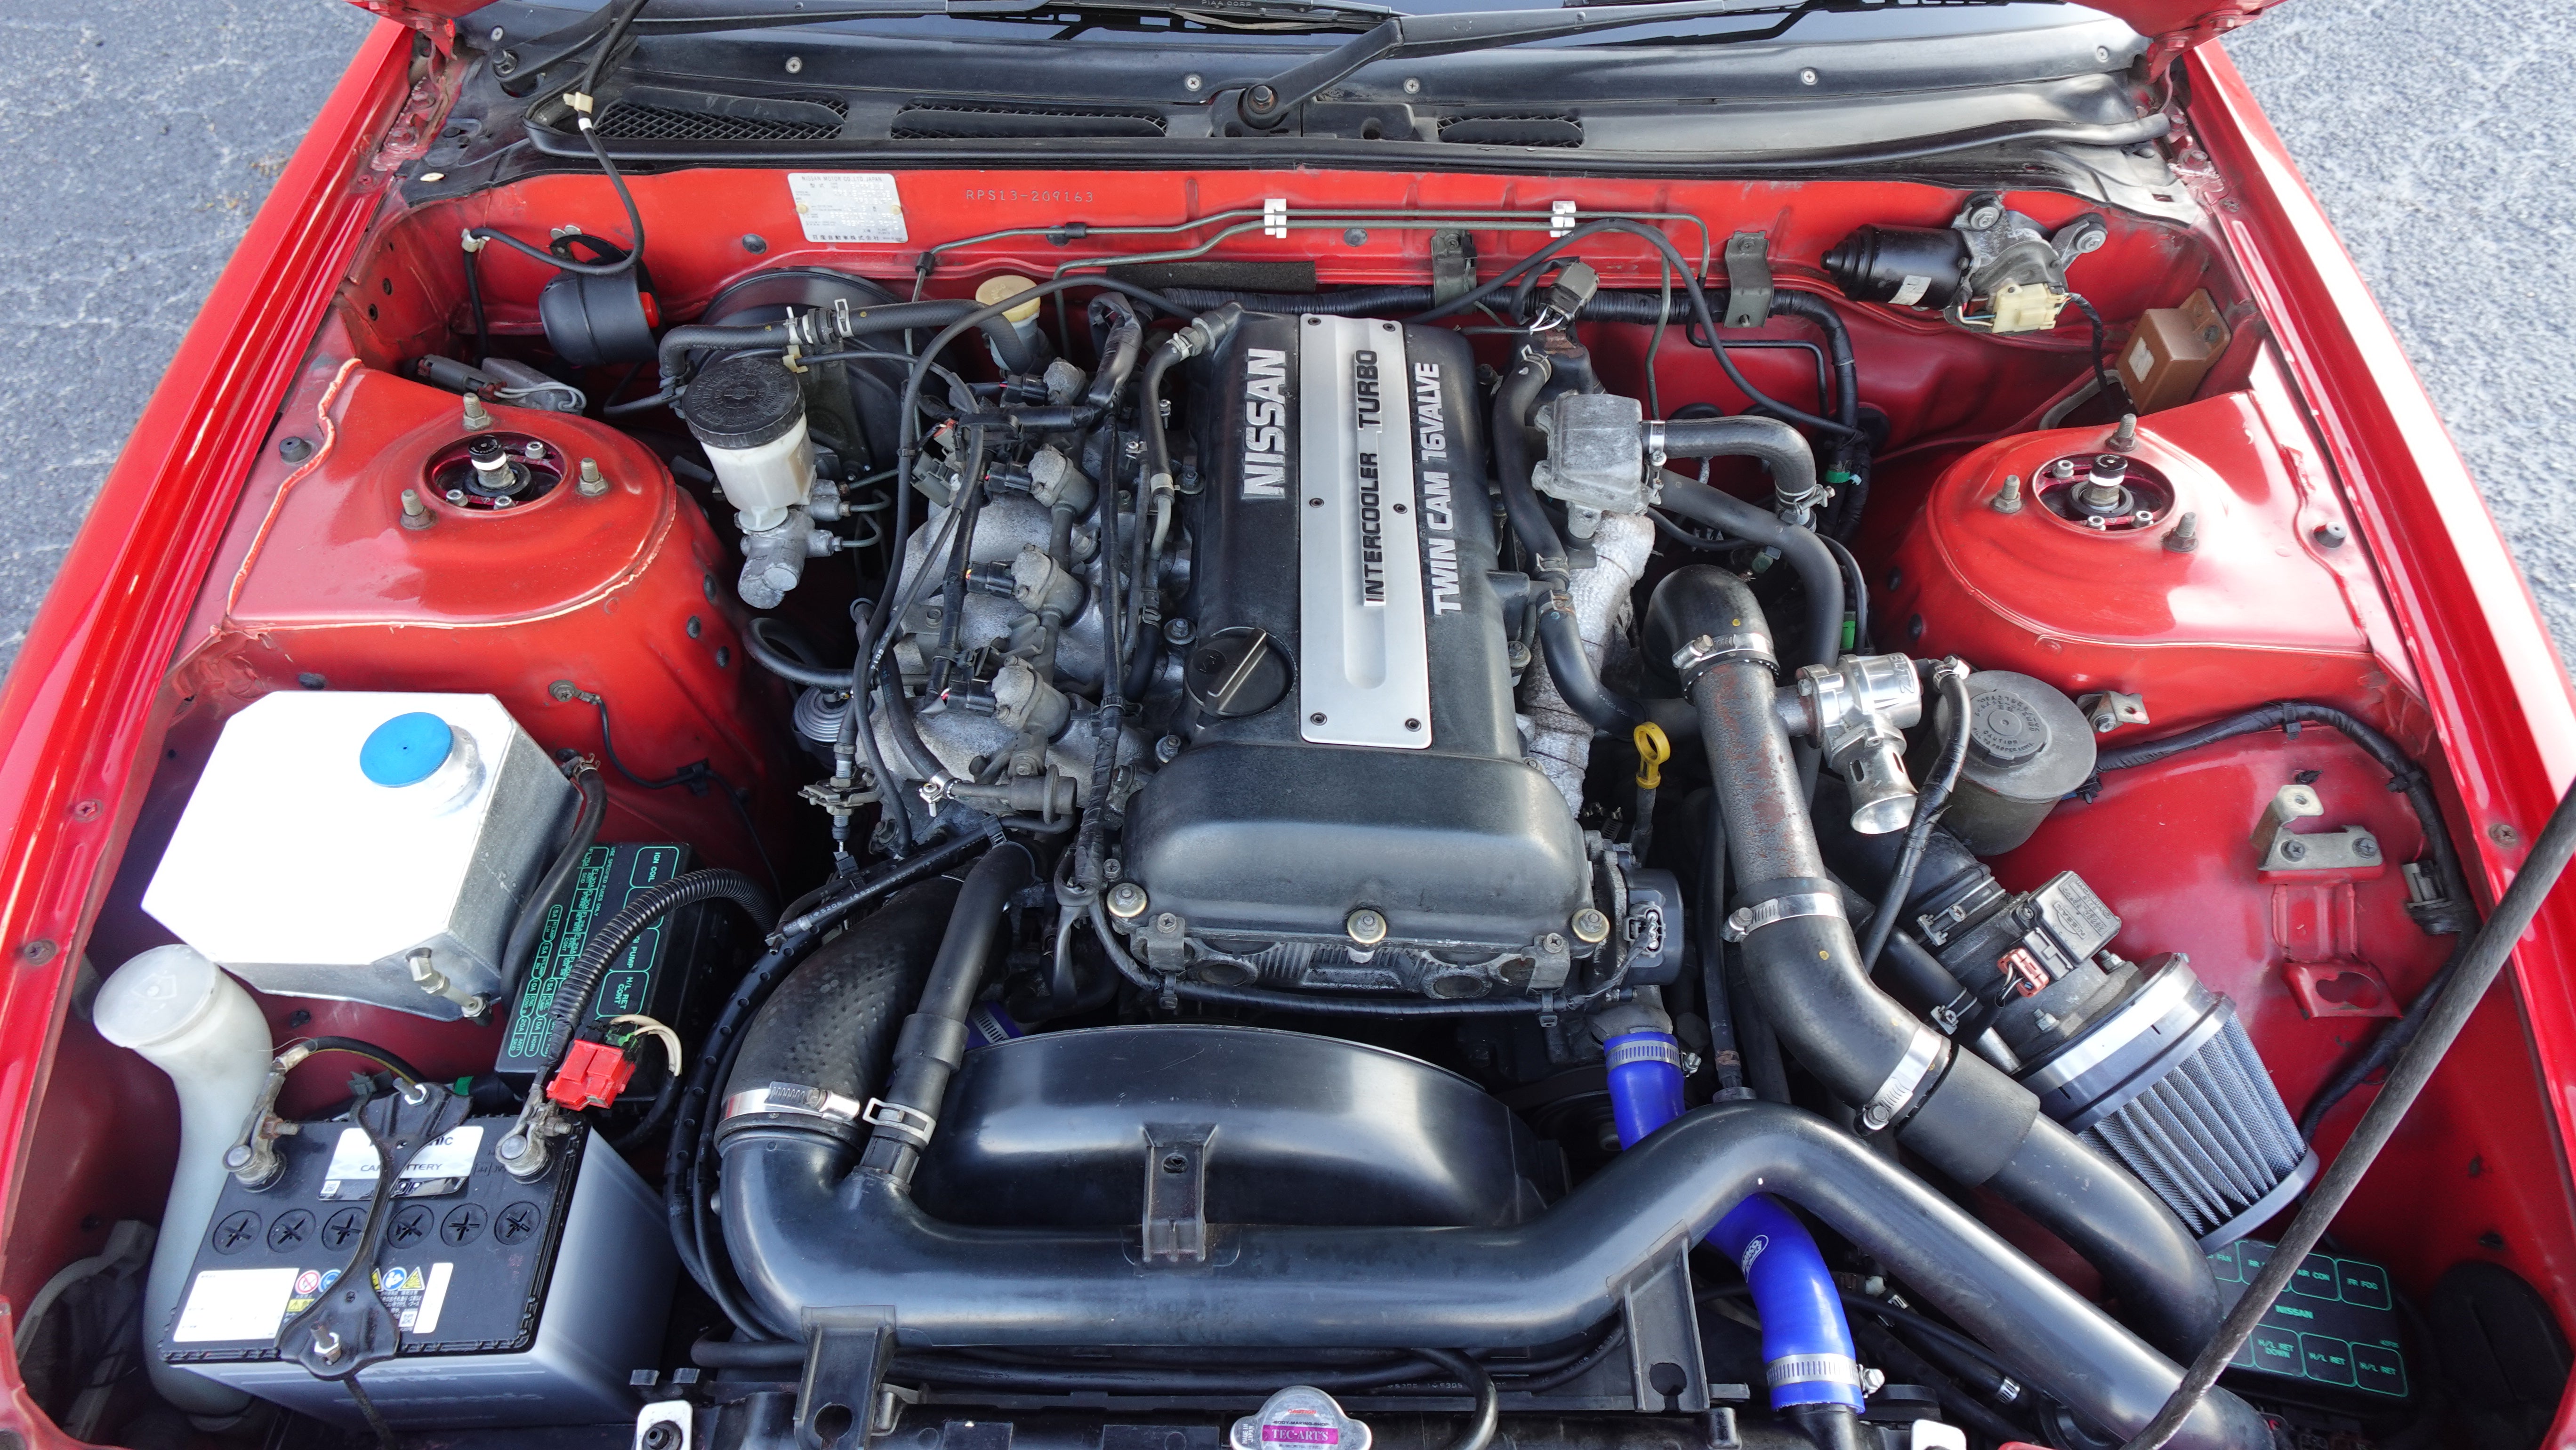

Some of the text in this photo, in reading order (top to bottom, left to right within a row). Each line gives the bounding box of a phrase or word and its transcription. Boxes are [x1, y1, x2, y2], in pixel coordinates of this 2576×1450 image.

[966, 189, 1093, 202] RPS13-209163
[1242, 348, 1286, 499] NISSAN
[1355, 349, 1385, 602] INTERCOOLER TURBO
[1415, 362, 1462, 616] TWIN CAM 16VALVE
[1889, 654, 1915, 694] BLITZ
[1983, 730, 2019, 745] CAUTION
[603, 859, 613, 884] SPECIFIED
[647, 852, 661, 883] IGN COIL
[597, 885, 606, 902] FUSES
[2076, 880, 2103, 911] HITACHI
[551, 907, 559, 918] 15A
[2056, 903, 2086, 937] NISSAN
[541, 943, 549, 955] 15A
[627, 946, 637, 969] PUMP
[530, 980, 539, 992] 10A
[546, 980, 555, 992] 15A
[619, 976, 634, 1010] H/L RET
[614, 983, 625, 1005] CONT
[543, 996, 552, 1010] FUEL
[518, 1019, 527, 1032] 20A
[534, 1018, 543, 1031] 10A
[529, 1036, 538, 1052] HORN
[2217, 1254, 2232, 1262] FAN
[2296, 1269, 2330, 1281] AIR CON
[2360, 1280, 2379, 1289] FOG
[2275, 1305, 2314, 1319] NISSAN
[2257, 1338, 2294, 1353] H/L RET
[2264, 1347, 2291, 1359] DOWN
[2308, 1352, 2346, 1365] H/L RET
[2359, 1361, 2397, 1375] H/L RET
[1272, 1429, 1329, 1441] TEC-ART'S
